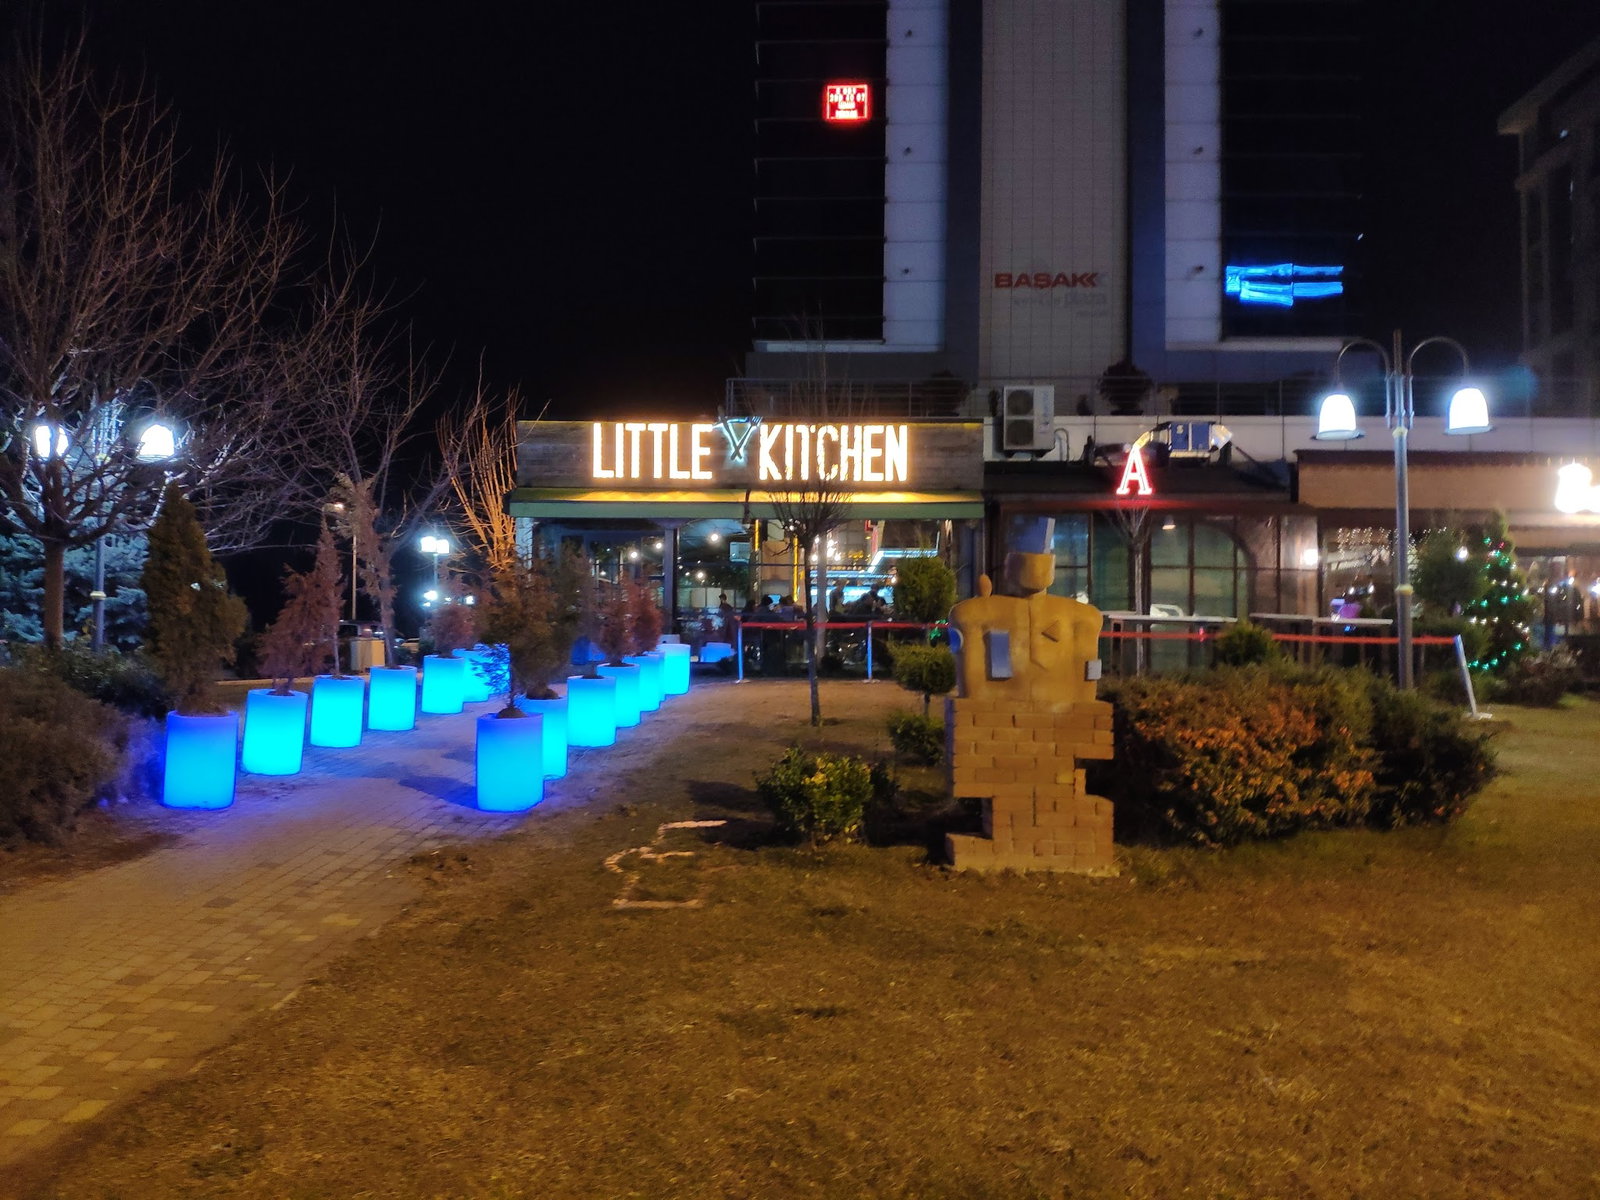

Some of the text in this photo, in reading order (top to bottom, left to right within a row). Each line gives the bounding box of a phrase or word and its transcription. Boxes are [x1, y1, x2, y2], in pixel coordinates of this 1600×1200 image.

[592, 422, 908, 482] LITTLE KITCHEN
[1116, 445, 1153, 495] A
